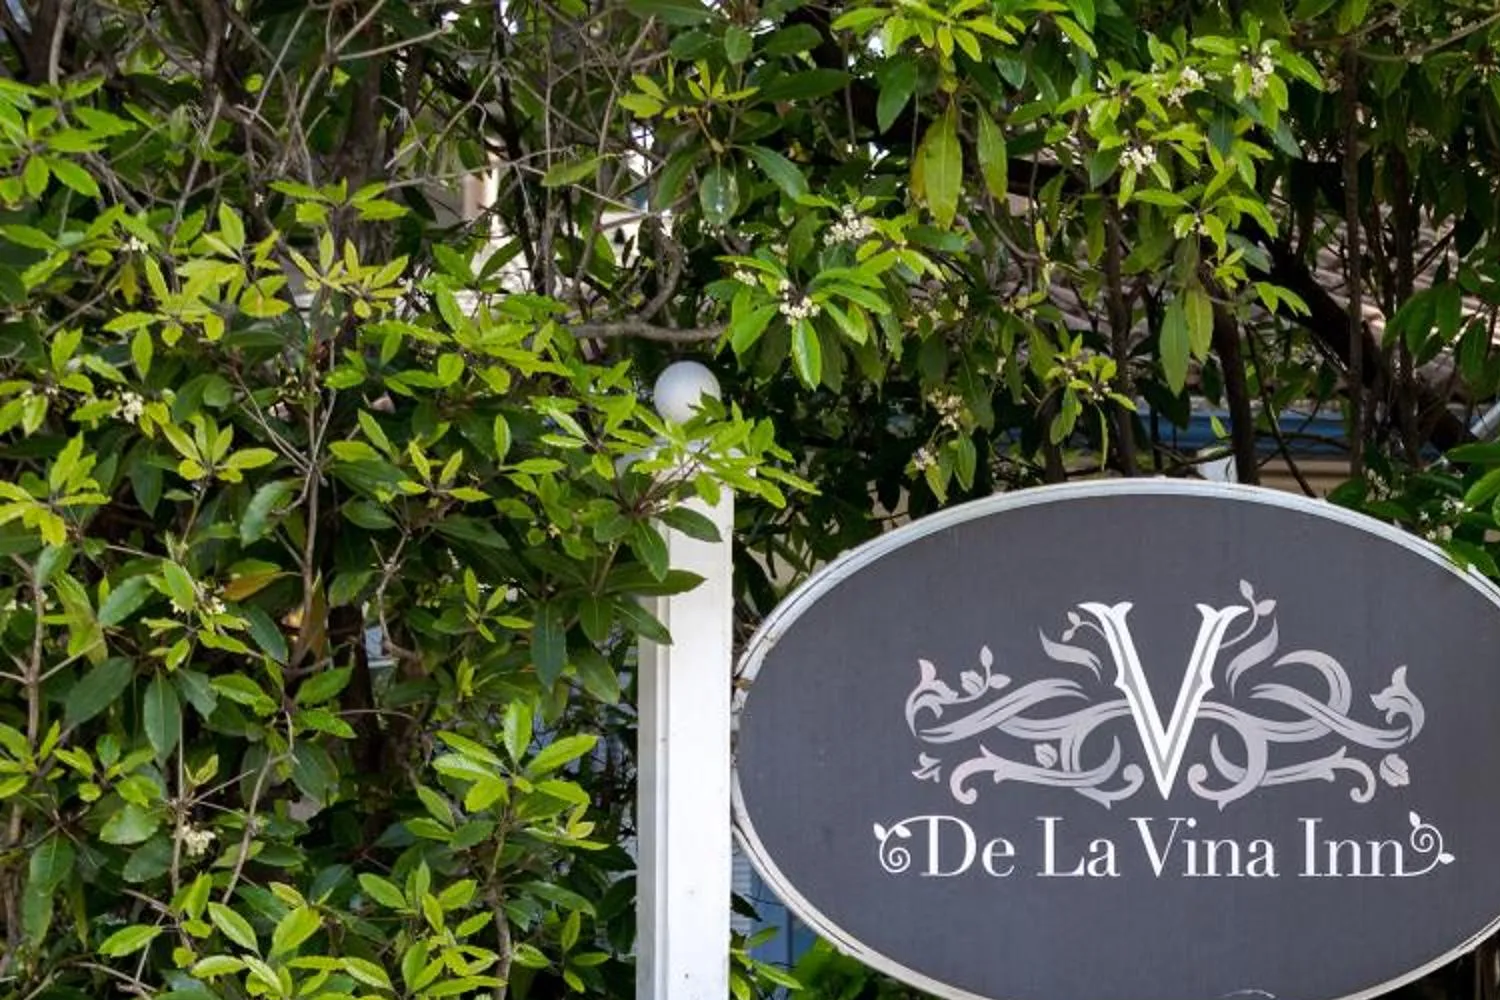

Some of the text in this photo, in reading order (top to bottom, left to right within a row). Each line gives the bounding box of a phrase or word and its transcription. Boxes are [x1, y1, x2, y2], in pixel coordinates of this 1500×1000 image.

[1078, 602, 1248, 800] V
[918, 815, 1406, 878] De La Vina Inn
